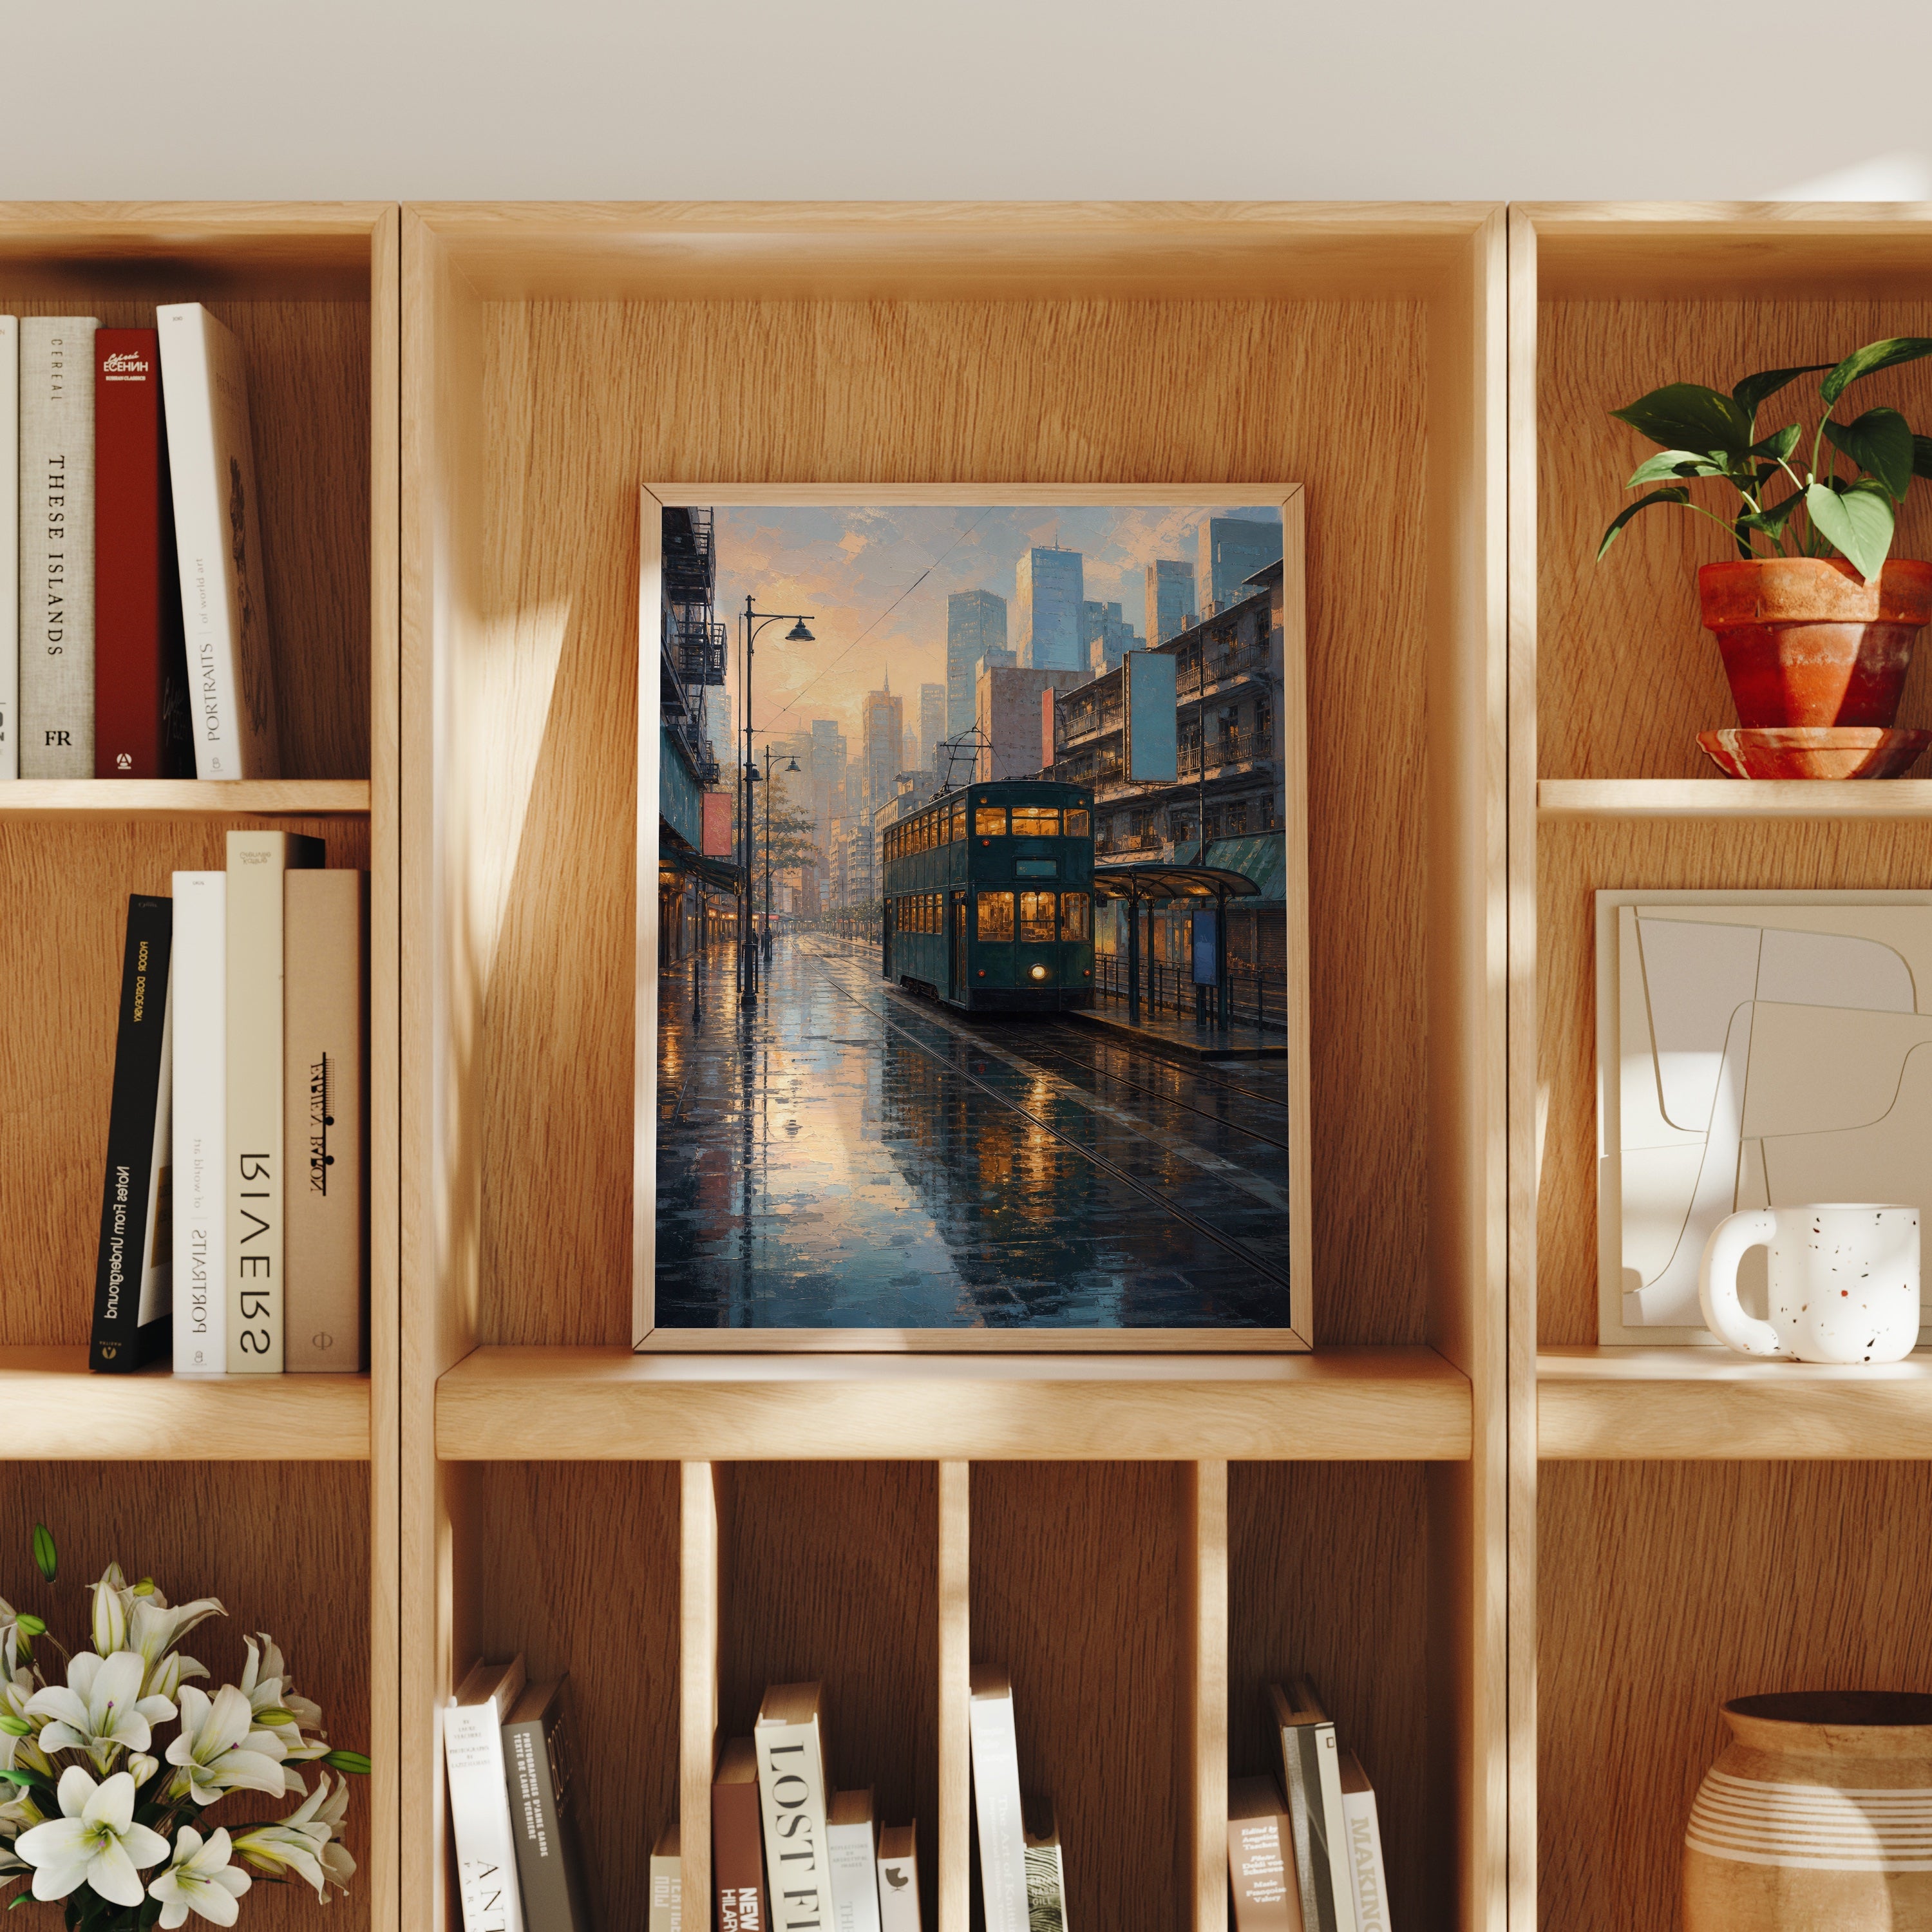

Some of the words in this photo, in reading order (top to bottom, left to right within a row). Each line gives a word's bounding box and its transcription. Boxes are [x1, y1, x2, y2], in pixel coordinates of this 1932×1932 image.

[51, 339, 62, 401] CEREAL
[104, 361, 149, 372] ЕСЕНИН
[49, 455, 65, 540] THESE
[196, 558, 204, 573] art
[48, 553, 64, 656] ISLANDS
[196, 577, 207, 608] world
[199, 613, 209, 624] of
[200, 643, 220, 741] PORTRAITS
[45, 730, 72, 746] FR
[514, 1734, 523, 1760] TEXTE
[518, 1761, 525, 1772] DE
[522, 1732, 539, 1797] PHOTOGRAPHIES
[520, 1774, 530, 1799] LAURE
[532, 1799, 544, 1829] D'ANNE
[770, 1741, 816, 1872] LOST
[999, 1795, 1009, 1827] The
[537, 1832, 548, 1857] GARDE
[1001, 1830, 1011, 1859] Art
[1242, 1826, 1268, 1836] Edited
[1003, 1862, 1014, 1880] of
[464, 1862, 477, 1932] PARI
[654, 1875, 670, 1907] NOW
[1032, 1897, 1053, 1906] GILL
[739, 1887, 759, 1931] NEW
